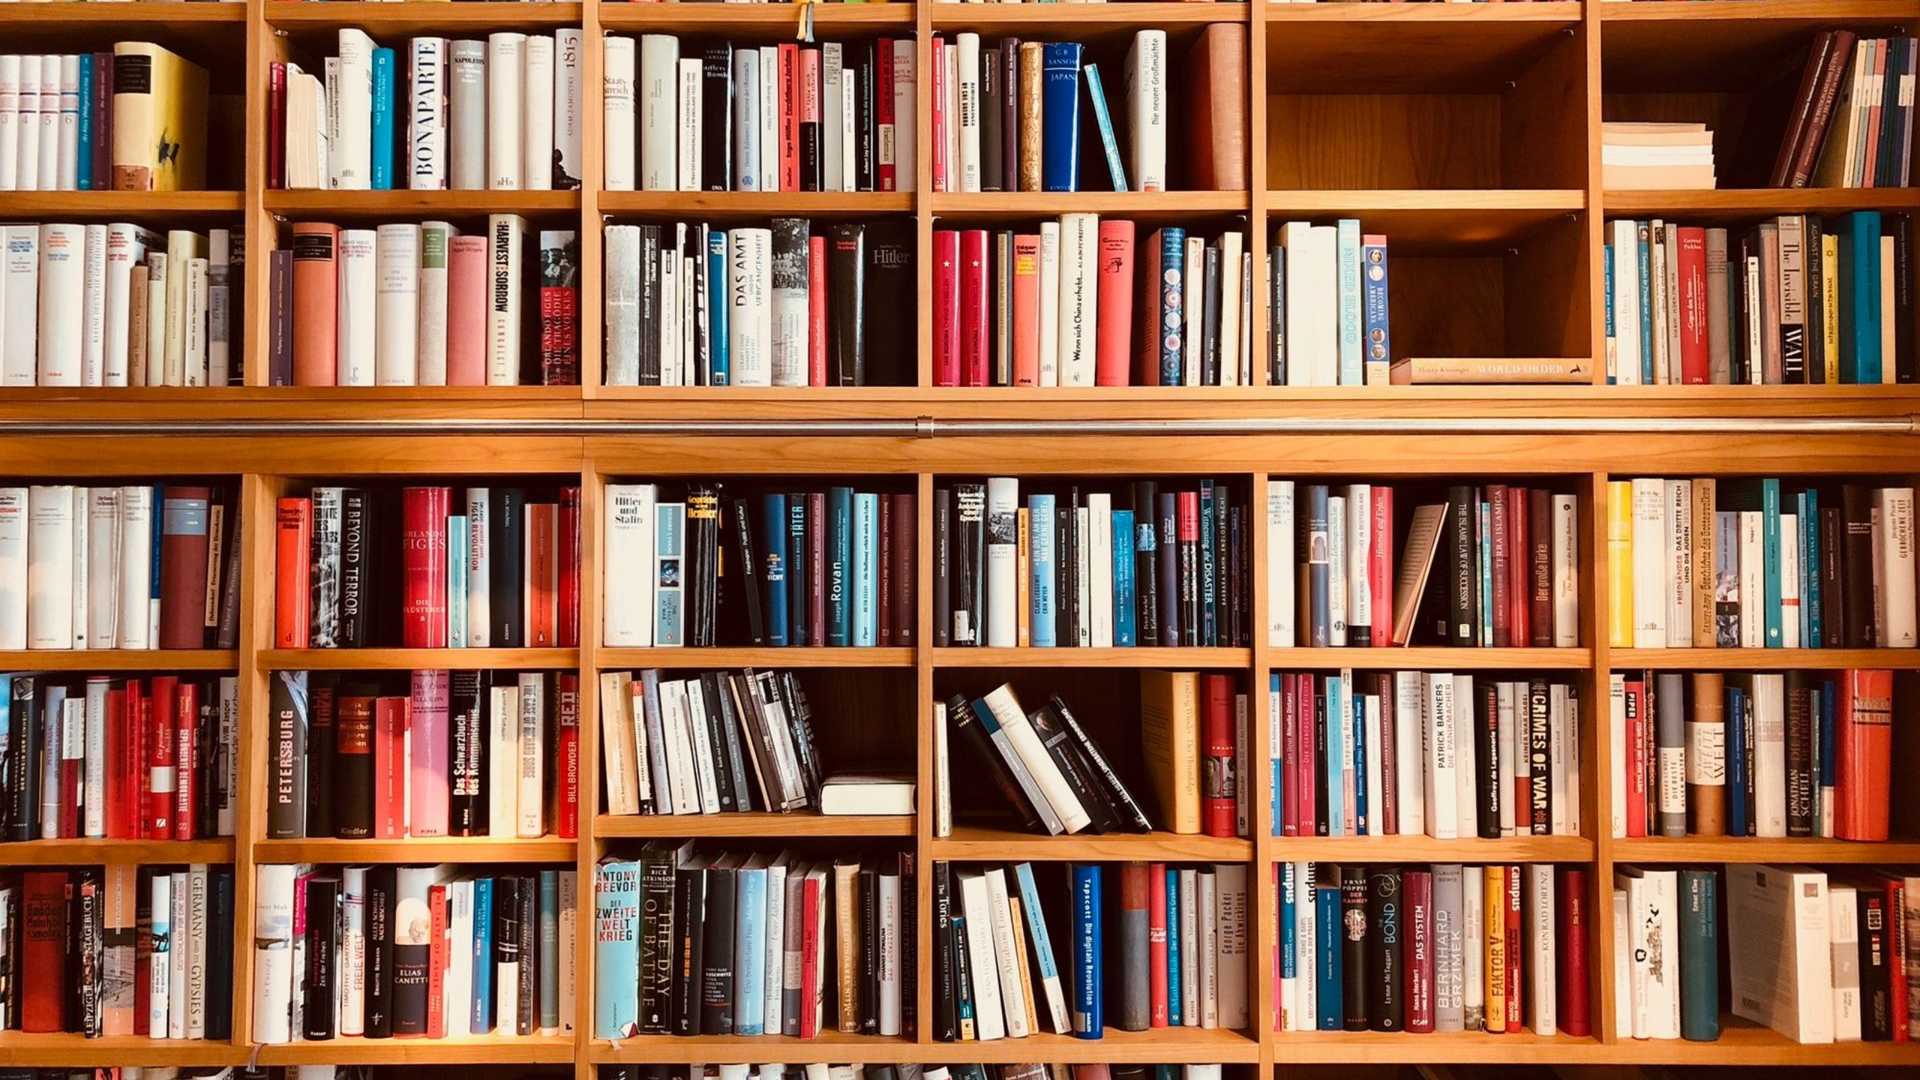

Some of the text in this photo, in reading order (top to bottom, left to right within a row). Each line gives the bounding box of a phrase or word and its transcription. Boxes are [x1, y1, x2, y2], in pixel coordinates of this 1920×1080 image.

[454, 57, 485, 67] NAPOLEON
[566, 37, 578, 69] 1815
[416, 43, 436, 175] BONAPARTE
[1151, 88, 1160, 112] neuen
[1151, 114, 1160, 125] Die
[496, 225, 509, 266] HARVEST
[873, 250, 911, 265] Hitler
[495, 271, 508, 313] SORROW
[736, 234, 747, 306] DAS AMT
[1784, 244, 1803, 321] The Invisible
[1073, 302, 1082, 323] China
[1073, 340, 1082, 362] Wenn
[1477, 364, 1521, 374] WORLD
[1523, 364, 1563, 374] ORDER
[1785, 329, 1802, 375] WALL
[615, 497, 642, 506] Hitler
[615, 516, 643, 524] Stalin
[620, 507, 637, 515] und
[792, 506, 804, 537] TÄTER
[1376, 519, 1384, 530] auf
[1460, 504, 1468, 515] THE
[345, 511, 361, 617] BEYOND TERROR
[471, 524, 479, 571] REVOLUTION
[830, 562, 842, 623] Joseph Rovan
[1204, 563, 1212, 604] DISASTER
[1536, 544, 1549, 601] Der große Türke
[562, 693, 575, 727] RED
[1437, 684, 1446, 769] PATRICK BAHNERS
[279, 710, 293, 803] PETERSBURG
[454, 715, 466, 796] Das Schwarzbuch
[467, 709, 480, 796] des Kommunismus
[567, 742, 577, 803] BILL BROWDER
[1446, 753, 1454, 769] DIE
[1490, 771, 1498, 779] de
[1533, 695, 1547, 810] CRIMES OF WAR
[1703, 729, 1713, 780] ZWEITE
[1714, 728, 1725, 779] WELT
[1791, 769, 1799, 816] JONATHAN
[597, 872, 637, 882] ANTONY
[597, 882, 637, 893] BEEVOR
[1511, 867, 1520, 912] campus
[597, 907, 637, 919] ZWEITE
[939, 896, 950, 929] Tories
[1384, 903, 1397, 944] BOND
[1415, 906, 1424, 960] DAS SYSTEM
[1541, 871, 1549, 952] KONRAD LORENZ
[191, 877, 203, 1014] GERMANY GYPSIES
[354, 933, 363, 990] FREIE WELT
[643, 899, 656, 1007] OF BATTLE
[656, 912, 670, 997] THE DAY
[1084, 879, 1094, 1006] Tapscott Die digitale Revolution
[1438, 910, 1448, 1008] BERNHARD
[1452, 929, 1461, 1008] GRZIMEK
[1490, 936, 1503, 997] FAKTOR V
[85, 985, 94, 1034] LEIPZIGER
[1384, 985, 1392, 1005] Lynne
